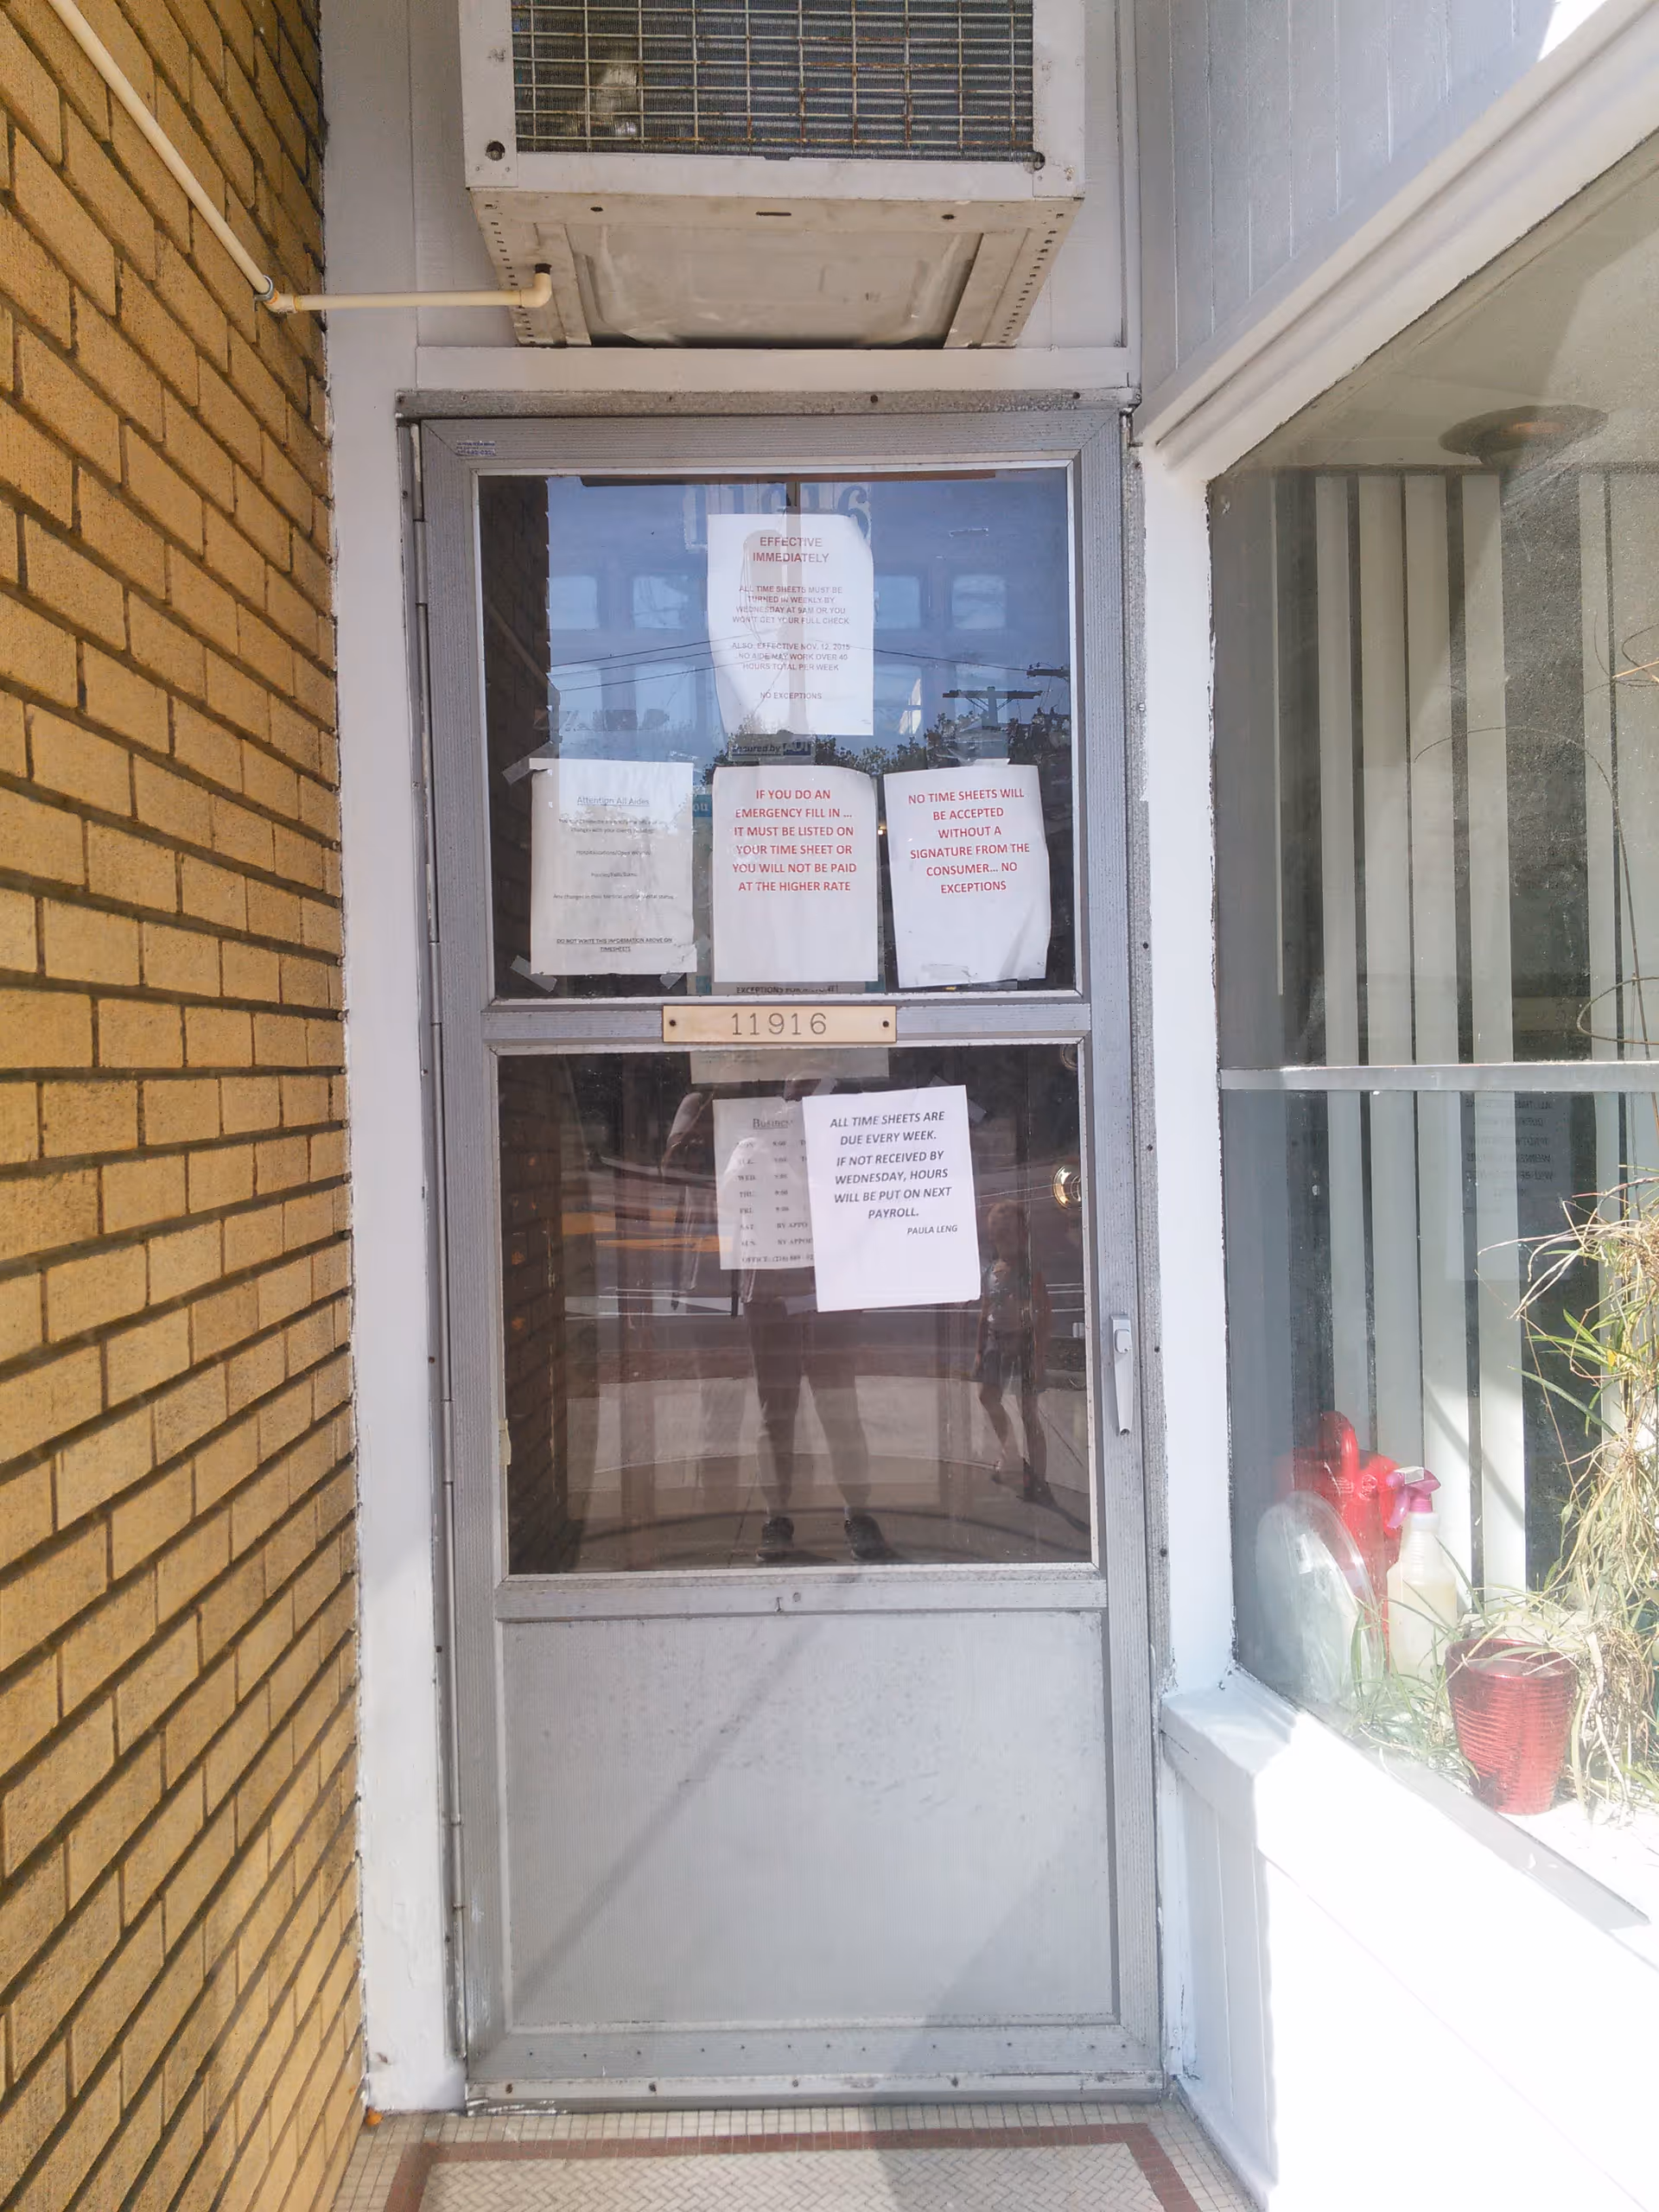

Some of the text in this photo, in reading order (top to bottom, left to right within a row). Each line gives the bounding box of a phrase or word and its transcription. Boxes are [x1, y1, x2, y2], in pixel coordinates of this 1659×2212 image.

[760, 537, 822, 547] EFFECTIVE
[753, 552, 830, 563] IMMEDIATELY
[776, 585, 806, 594] SHEETS
[755, 789, 831, 799] IF YOU DO AN
[908, 788, 1025, 804] NO TIME SHEETS WILL
[576, 796, 615, 805] Attention
[628, 797, 650, 805] Aides
[735, 808, 802, 818] EMERGENCY
[805, 809, 825, 818] FILL
[829, 809, 840, 817] IN
[932, 807, 1004, 821] BE ACCEPTED
[734, 826, 854, 836] IT MUST BE LISTED ON
[938, 826, 1002, 838] WITHOUT A
[735, 844, 853, 855] YOUR TIME SHEET OR
[910, 842, 1030, 860] SIGNATURE FROM THE
[732, 863, 856, 873] YOU WILL NOT BE PAID
[926, 861, 1018, 877] CONSUMER... NO
[738, 881, 851, 892] AT THE HIGHER RATE
[940, 880, 1007, 893] EXCEPTIONS
[731, 1012, 827, 1036] 11916
[830, 1110, 945, 1128] ALL TIME SHEETS ARE
[840, 1129, 937, 1146] DUE EVERY WEEK.
[836, 1149, 944, 1166] IF NOT RECEIVED BY
[835, 1168, 948, 1185] WEDNESDAY, HOURS
[834, 1186, 952, 1204] WILL BE PUT ON NEXT
[868, 1207, 919, 1219] PAYROLL.
[906, 1224, 958, 1235] PAULA LENG
